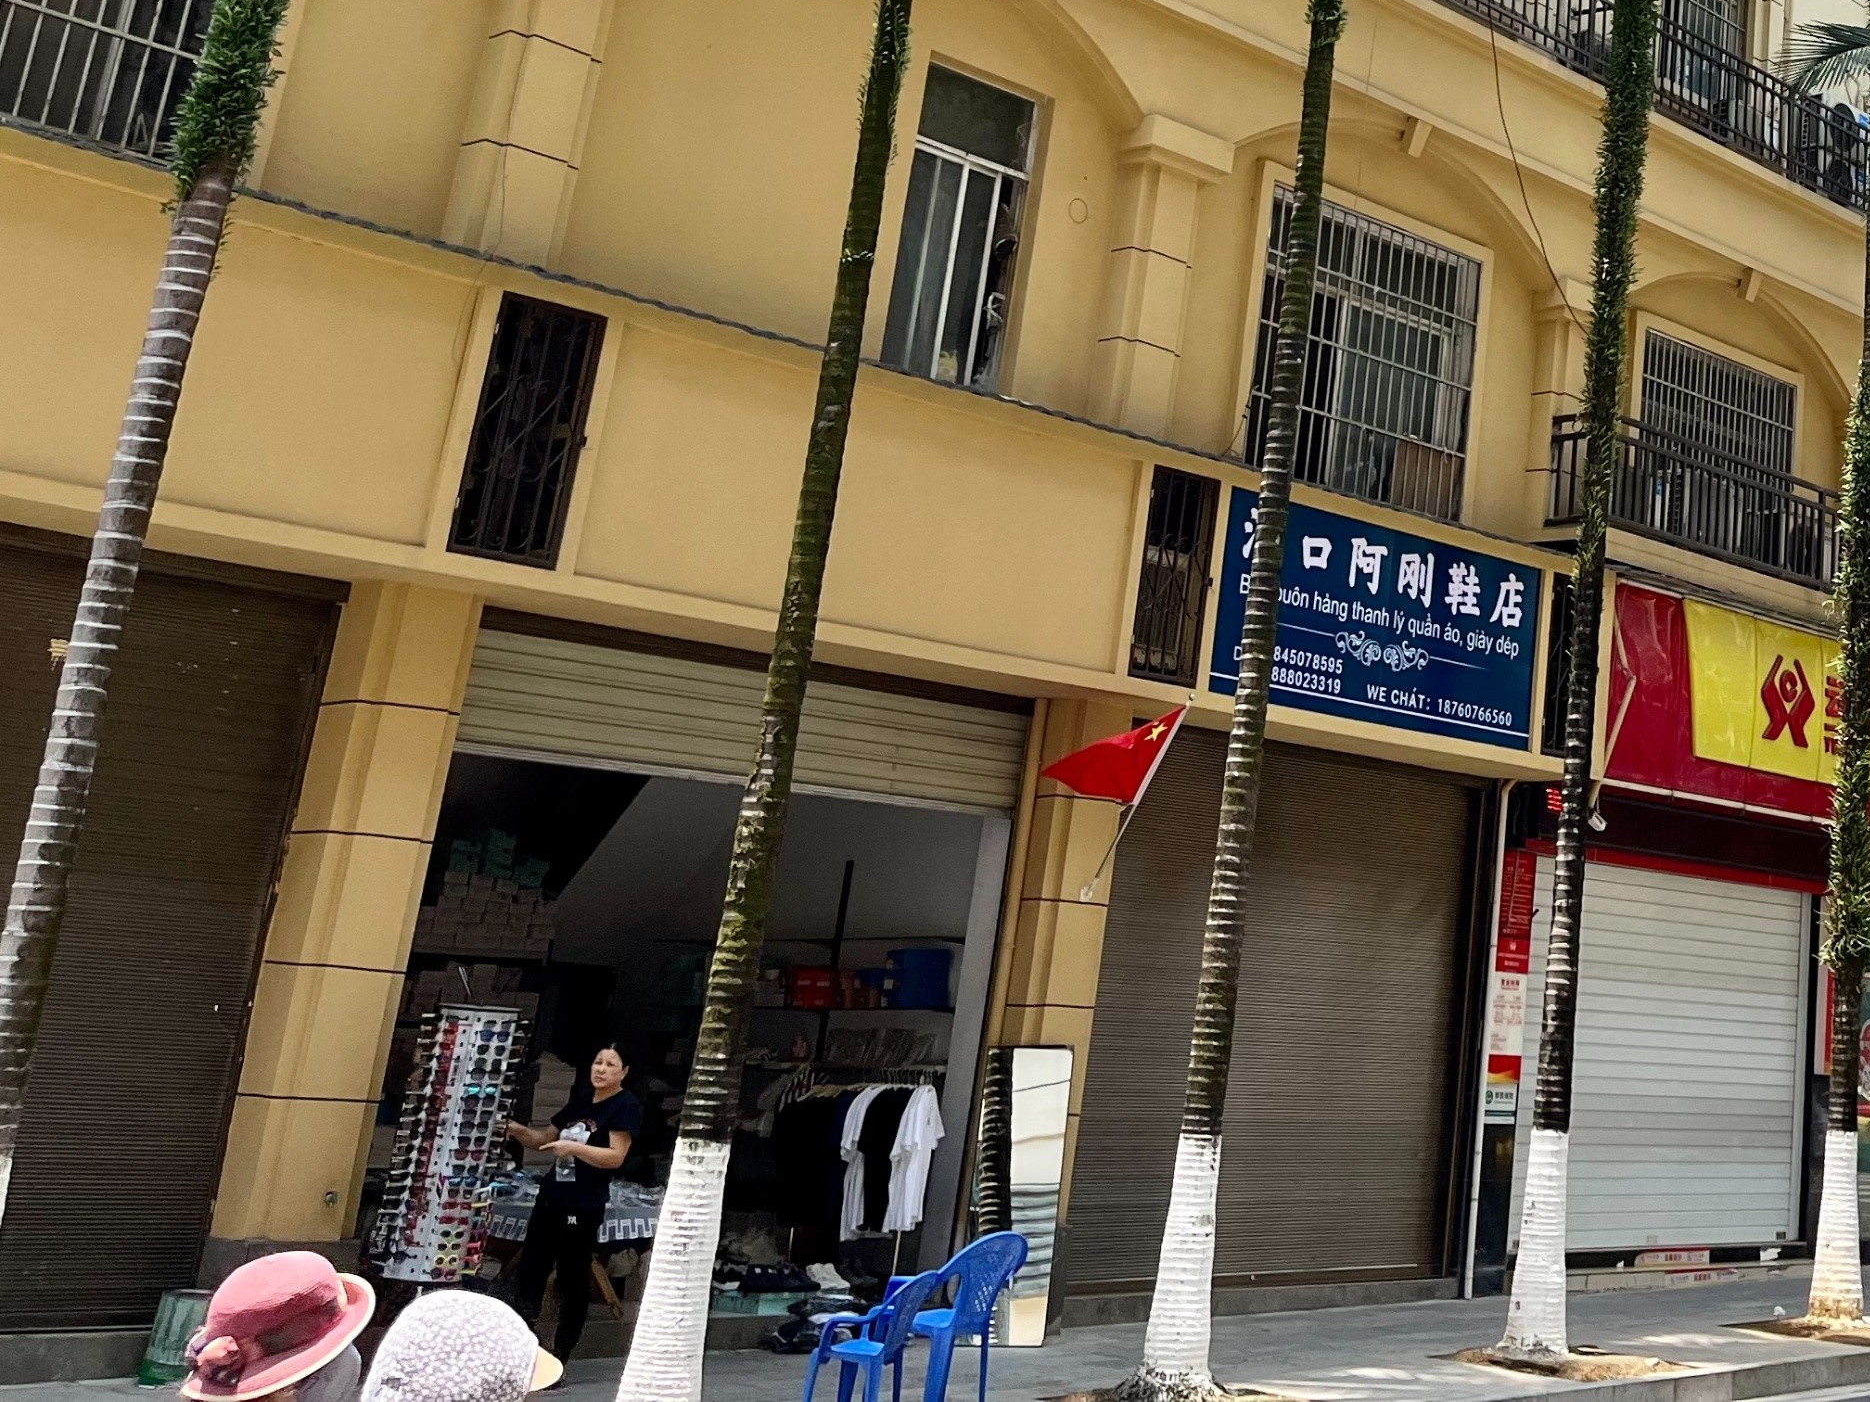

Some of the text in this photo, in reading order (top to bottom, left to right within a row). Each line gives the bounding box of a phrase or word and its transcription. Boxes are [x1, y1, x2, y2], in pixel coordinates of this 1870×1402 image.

[1351, 600, 1390, 628] thanh
[1366, 683, 1387, 703] WE
[1437, 698, 1513, 727] 18760766560
